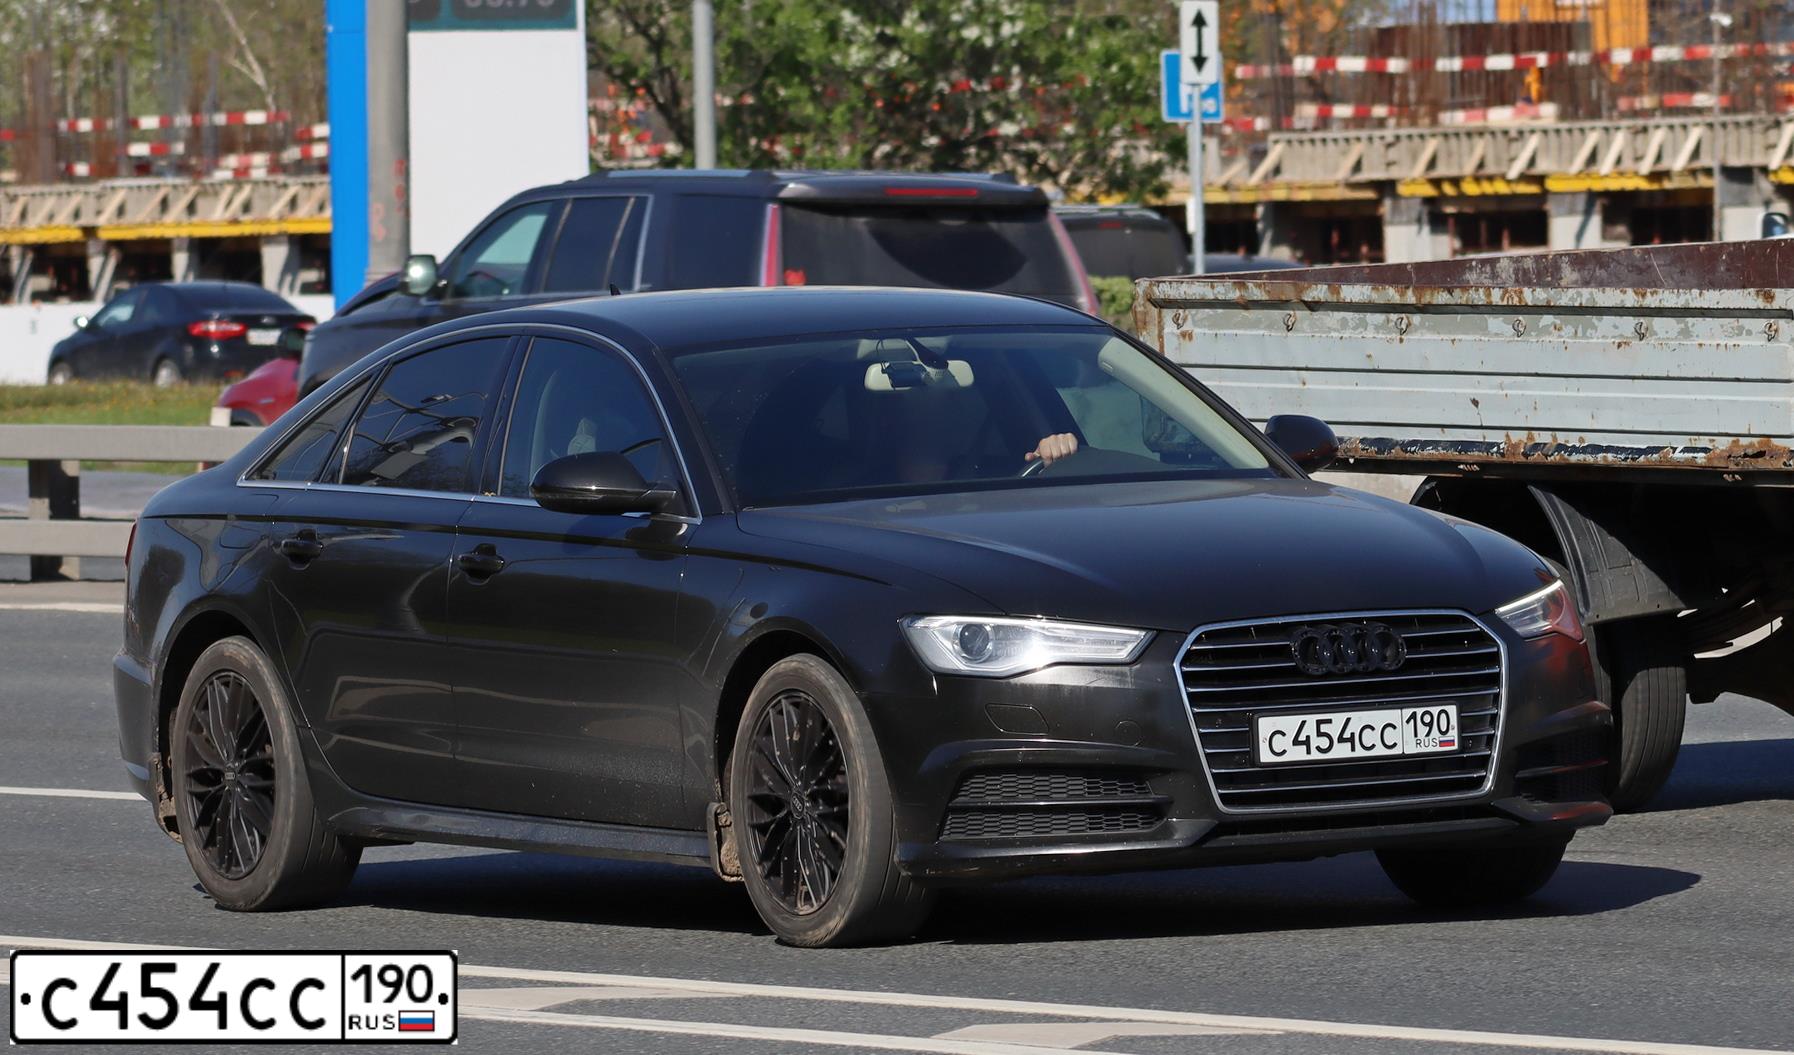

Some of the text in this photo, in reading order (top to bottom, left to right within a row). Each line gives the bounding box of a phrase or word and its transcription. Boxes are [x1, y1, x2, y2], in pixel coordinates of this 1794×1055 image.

[1268, 708, 1450, 757] C454CC 190
[1415, 738, 1438, 748] RUS
